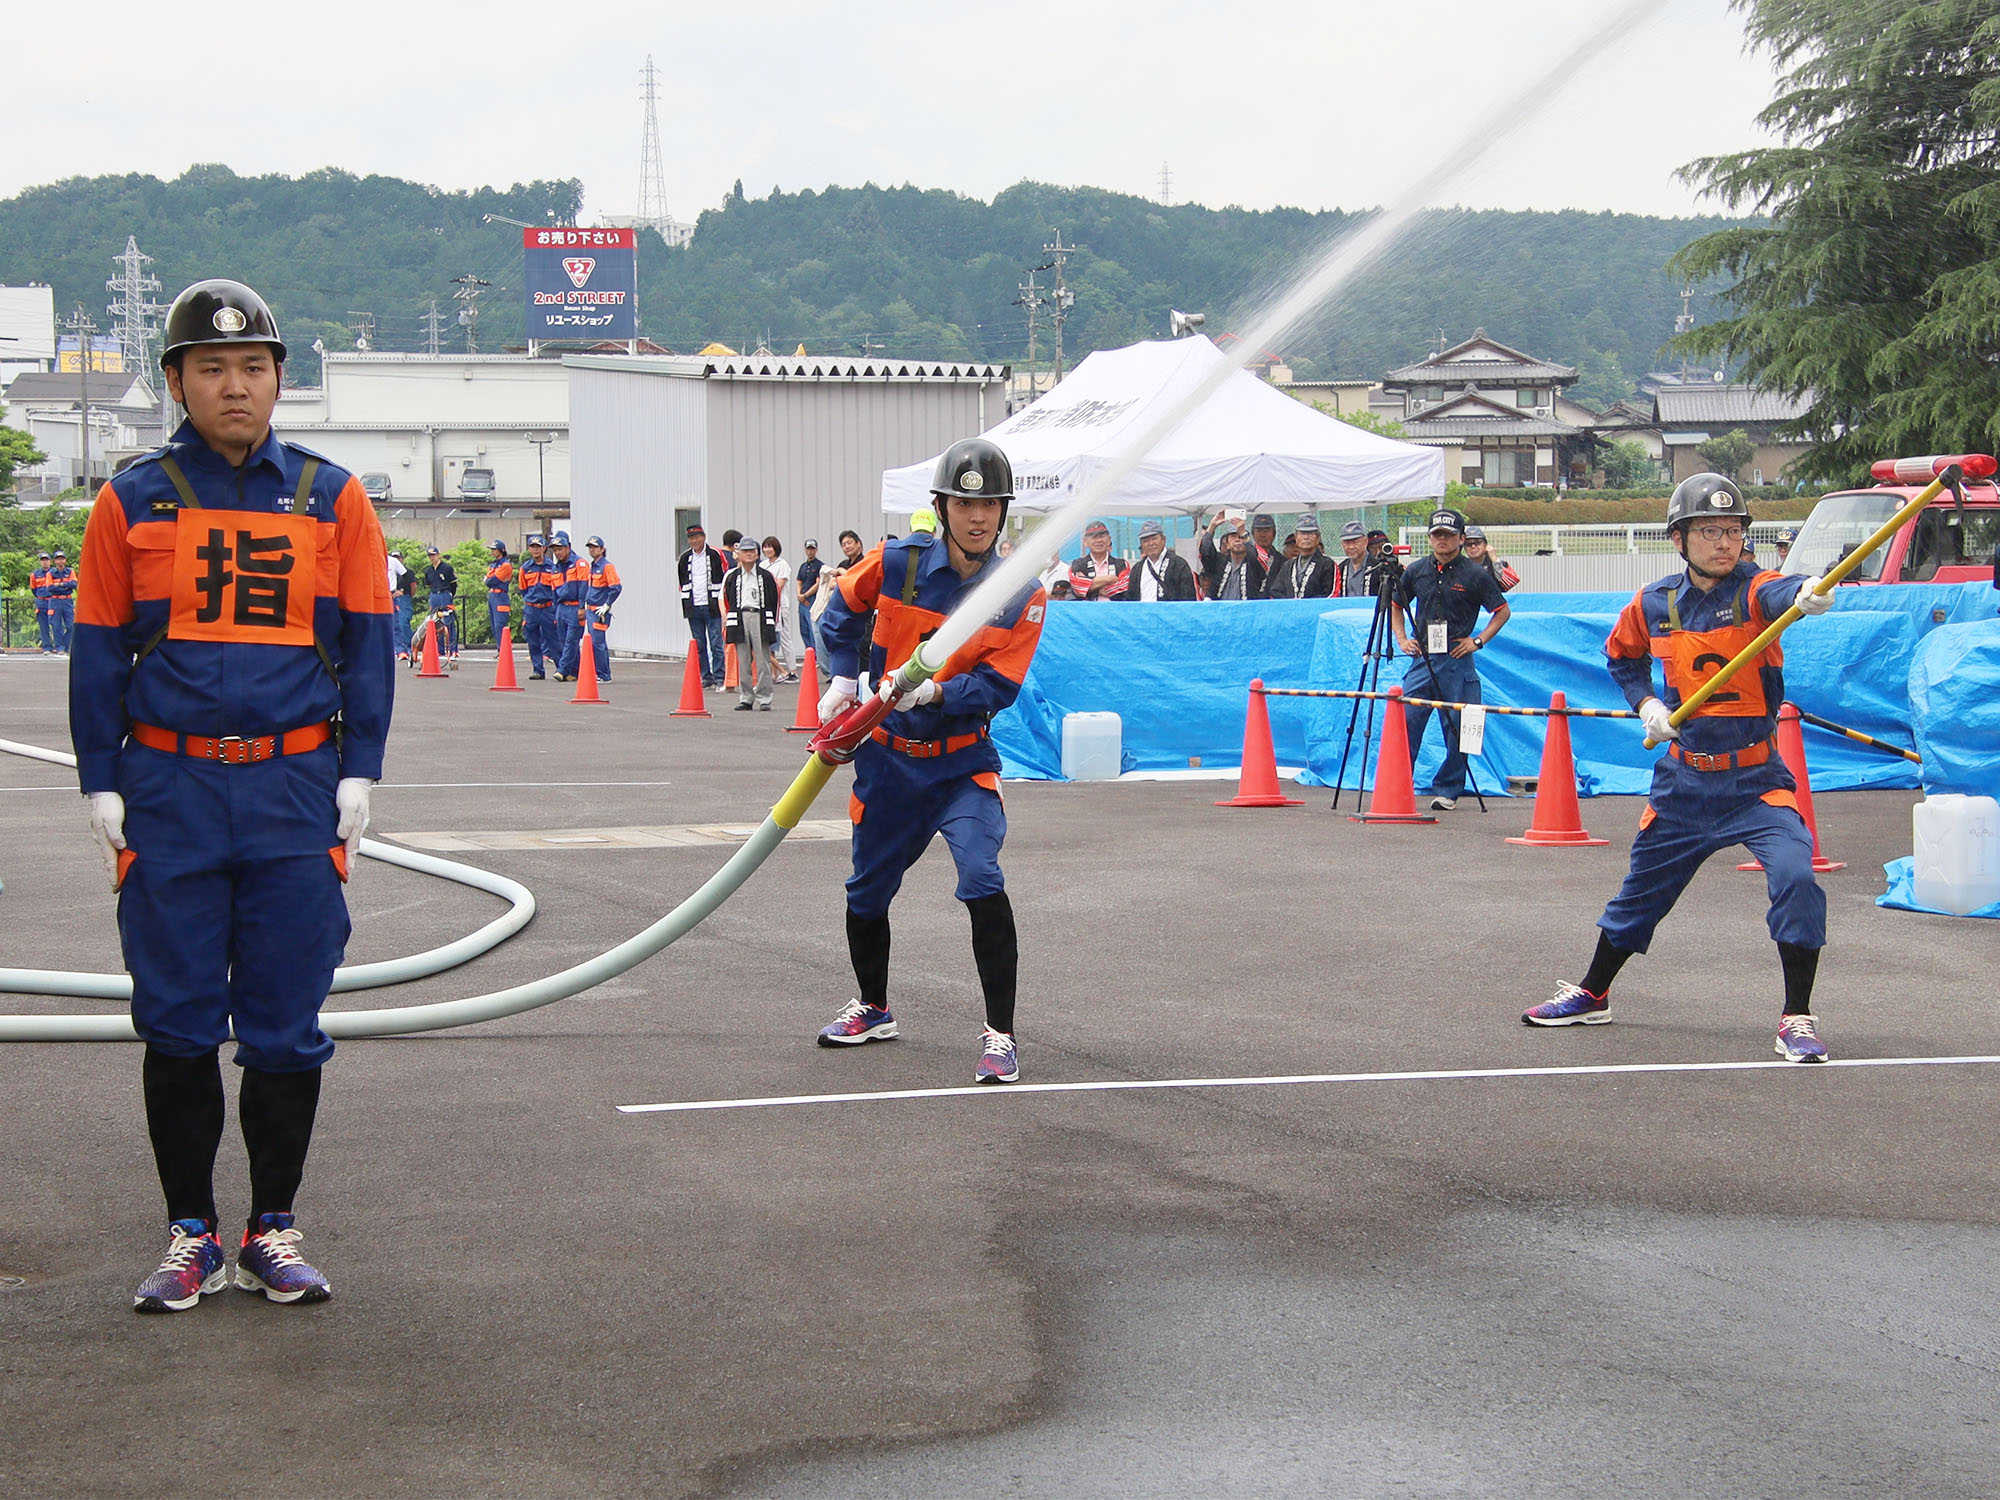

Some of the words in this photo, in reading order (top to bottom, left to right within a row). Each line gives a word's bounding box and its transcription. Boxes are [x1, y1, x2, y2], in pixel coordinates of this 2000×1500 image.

[537, 231, 620, 245] お売り下さい
[573, 262, 586, 277] 2
[534, 291, 565, 305] 2nd
[567, 291, 626, 305] STREET
[546, 314, 614, 326] リユースショップ
[195, 527, 296, 629] 指
[1692, 652, 1741, 704] 2
